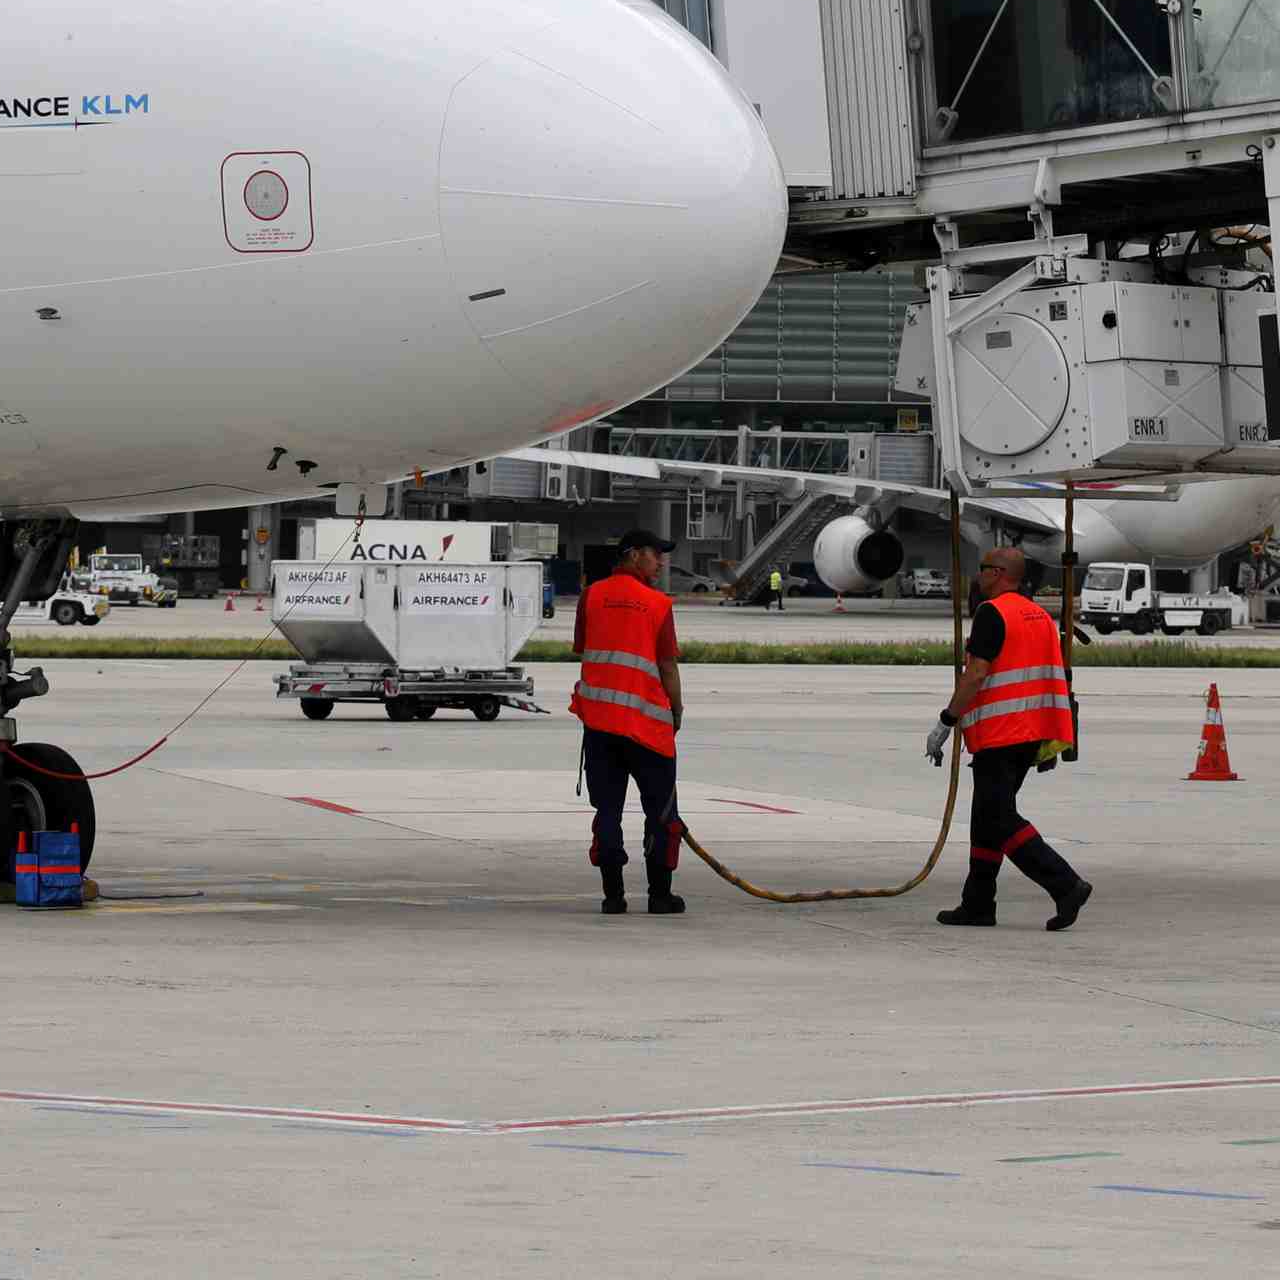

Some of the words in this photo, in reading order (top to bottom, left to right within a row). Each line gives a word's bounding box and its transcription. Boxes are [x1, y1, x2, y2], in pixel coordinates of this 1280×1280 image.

[81, 94, 149, 115] KLM
[1134, 418, 1165, 436] ENR.1
[1239, 425, 1268, 442] ENR.2
[350, 543, 427, 561] ACNA
[335, 571, 348, 583] AF
[418, 572, 470, 584] AKH64473
[473, 572, 488, 584] AF
[284, 595, 342, 605] AIRFRANCE
[412, 596, 478, 606] AIRFRANCE
